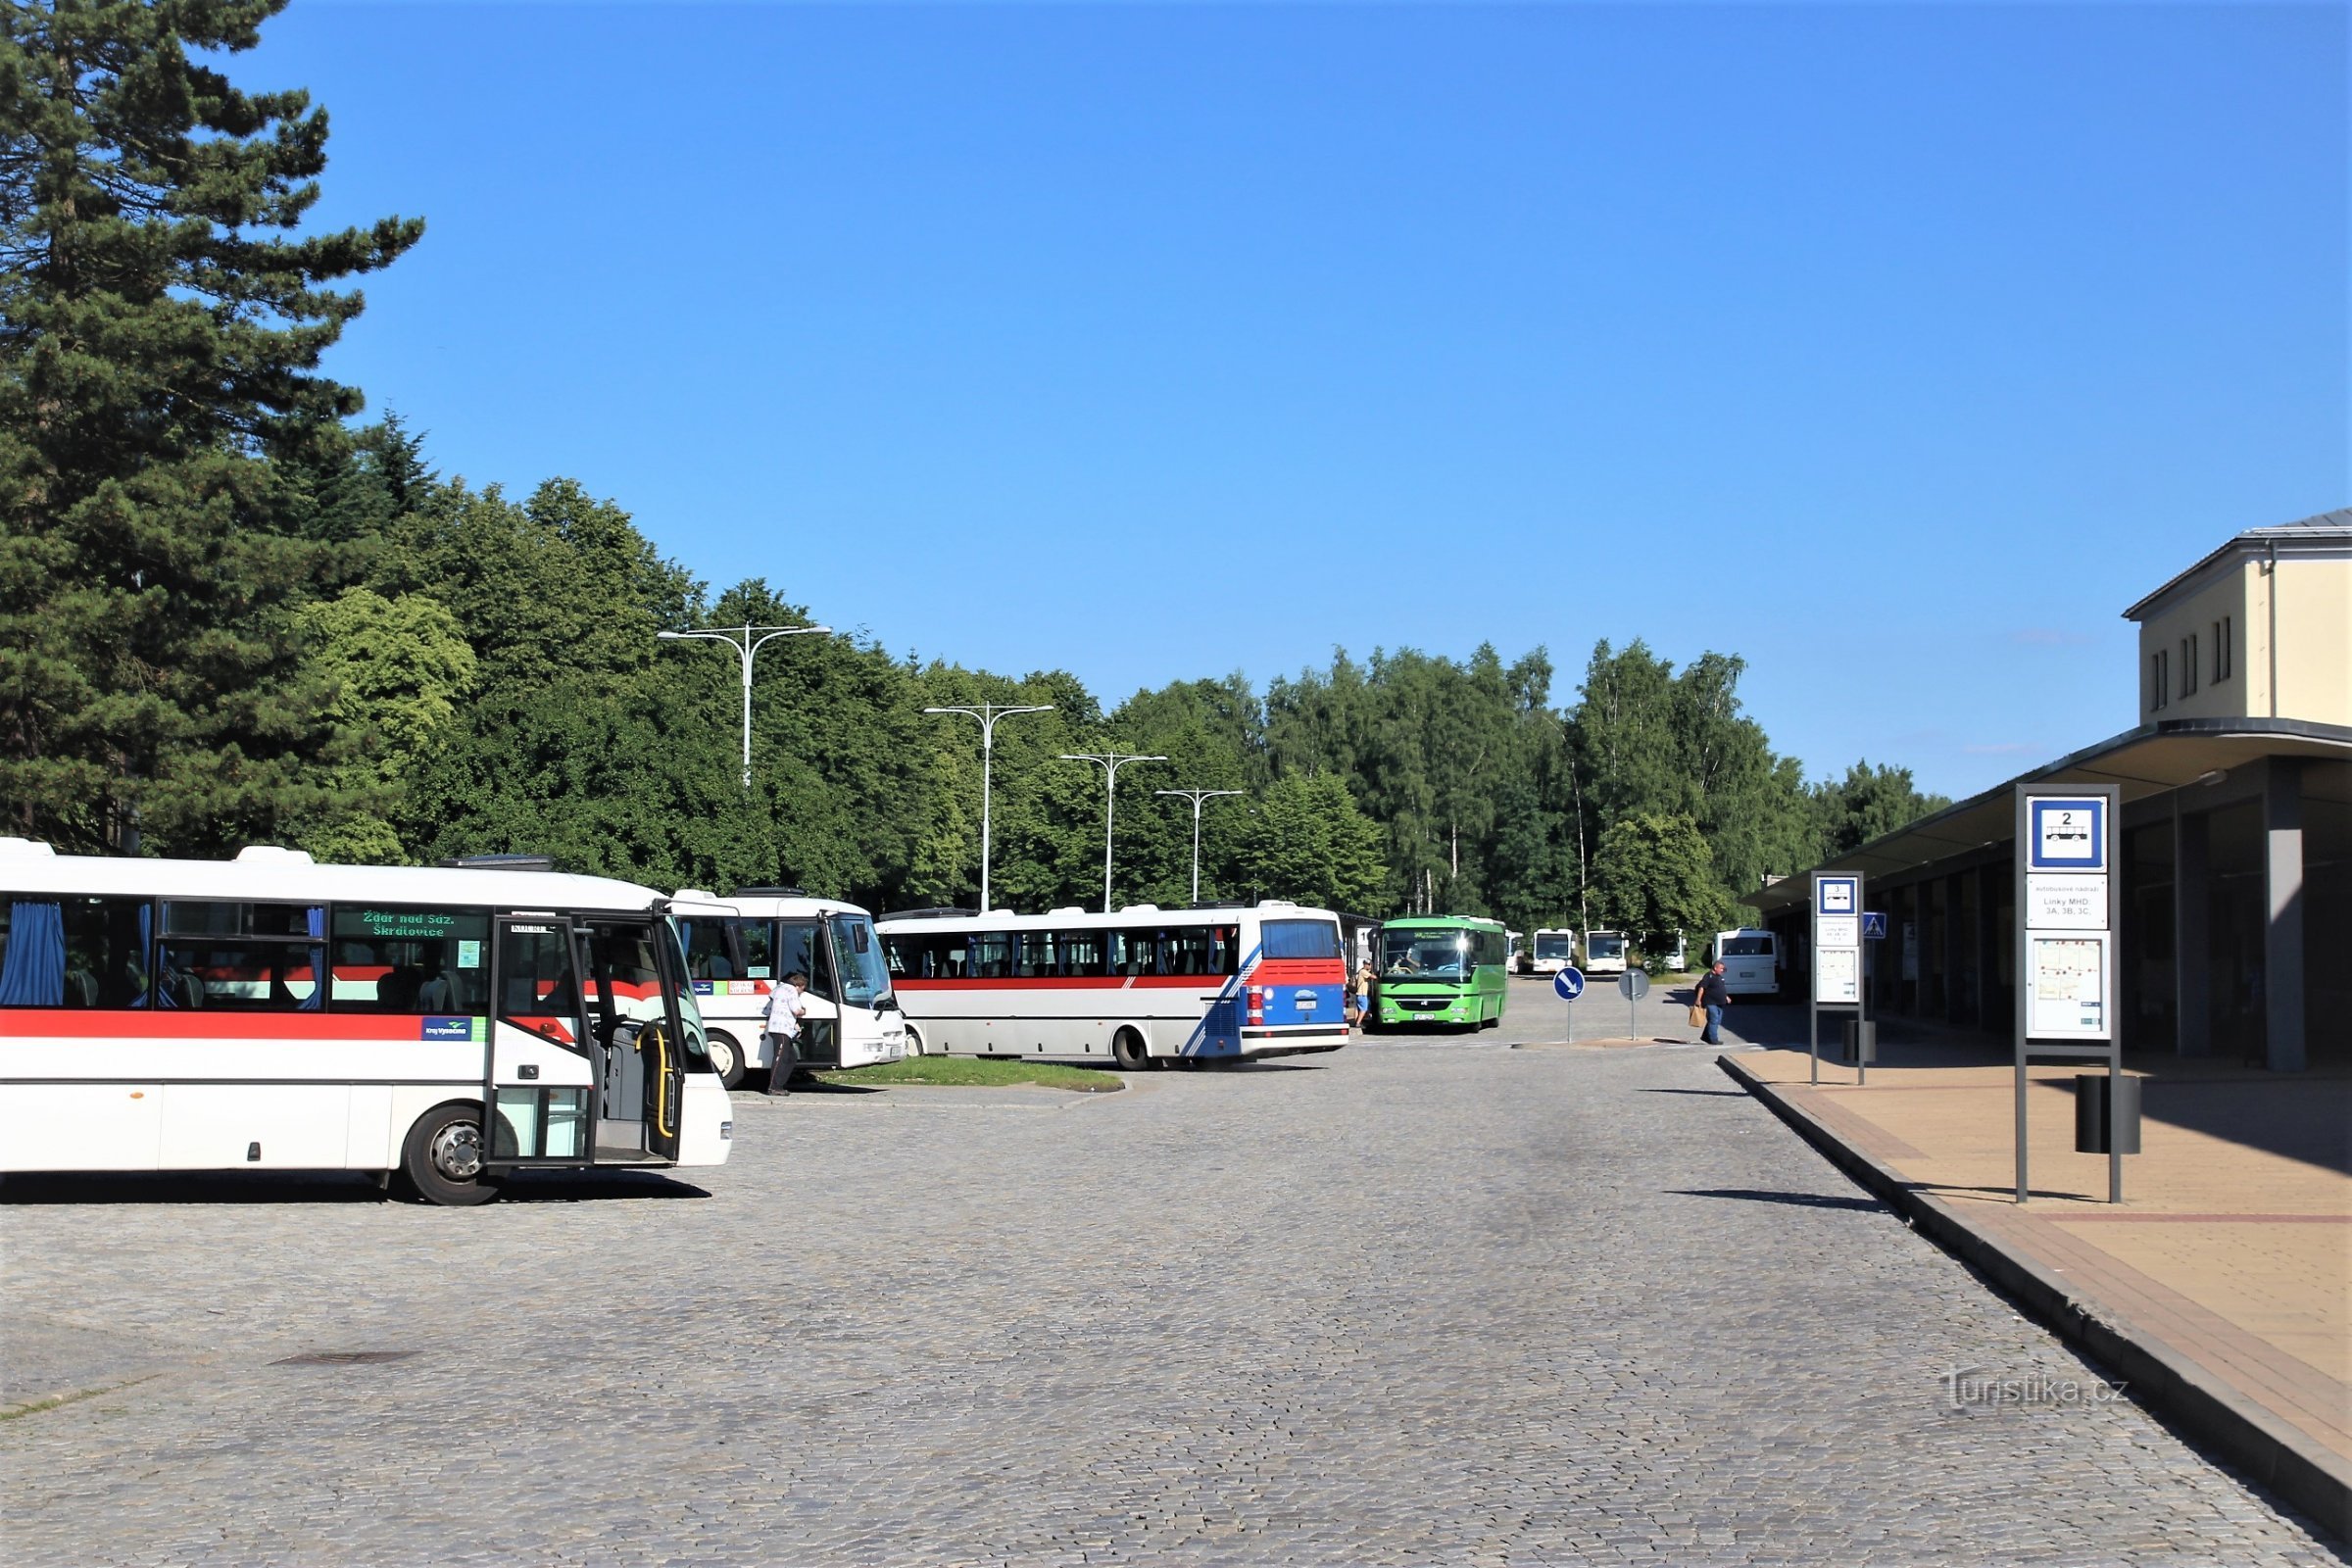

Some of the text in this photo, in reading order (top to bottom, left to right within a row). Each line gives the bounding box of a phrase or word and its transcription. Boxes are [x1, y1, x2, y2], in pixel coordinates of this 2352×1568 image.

[2062, 812, 2072, 825] 2
[2043, 898, 2066, 906] Linky
[399, 913, 423, 924] nad
[373, 922, 444, 937] Škrdlovice
